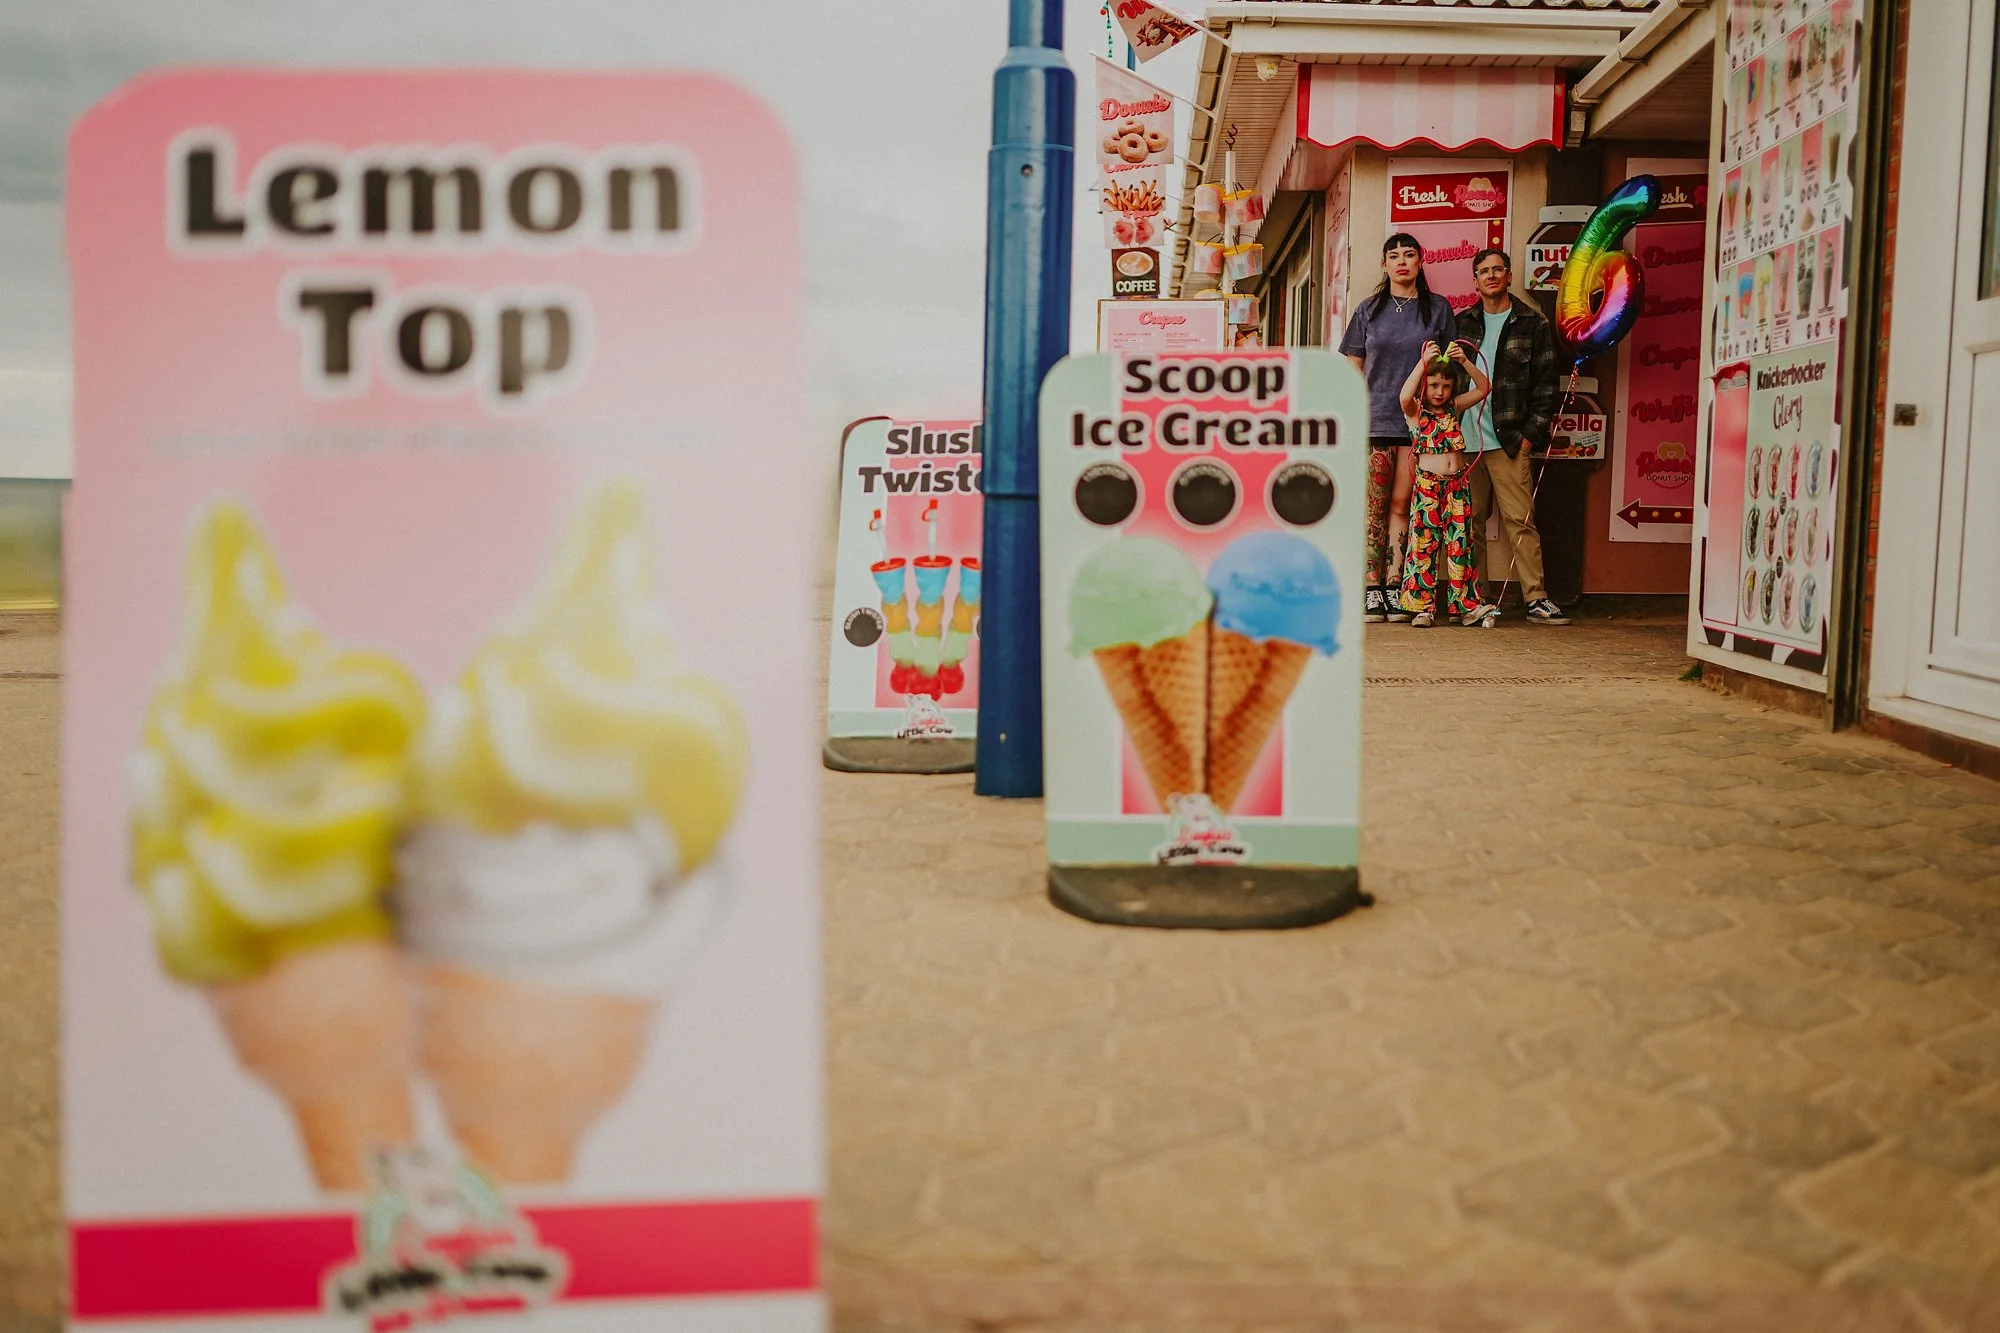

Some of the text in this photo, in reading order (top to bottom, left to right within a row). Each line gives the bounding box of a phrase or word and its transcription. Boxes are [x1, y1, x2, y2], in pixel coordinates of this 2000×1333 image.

[1100, 94, 1171, 120] Donuts
[184, 148, 682, 238] Lemon
[1399, 185, 1448, 204] Fresh
[1421, 240, 1480, 264] onuts
[1116, 280, 1157, 293] COFFEE
[299, 289, 571, 394] Top
[1125, 360, 1284, 400] Scoop
[1757, 359, 1826, 391] Knickerbocker
[1072, 411, 1337, 446] Ice Cream
[1773, 394, 1802, 432] Glory
[1647, 474, 1694, 483] DONUT SHOP
